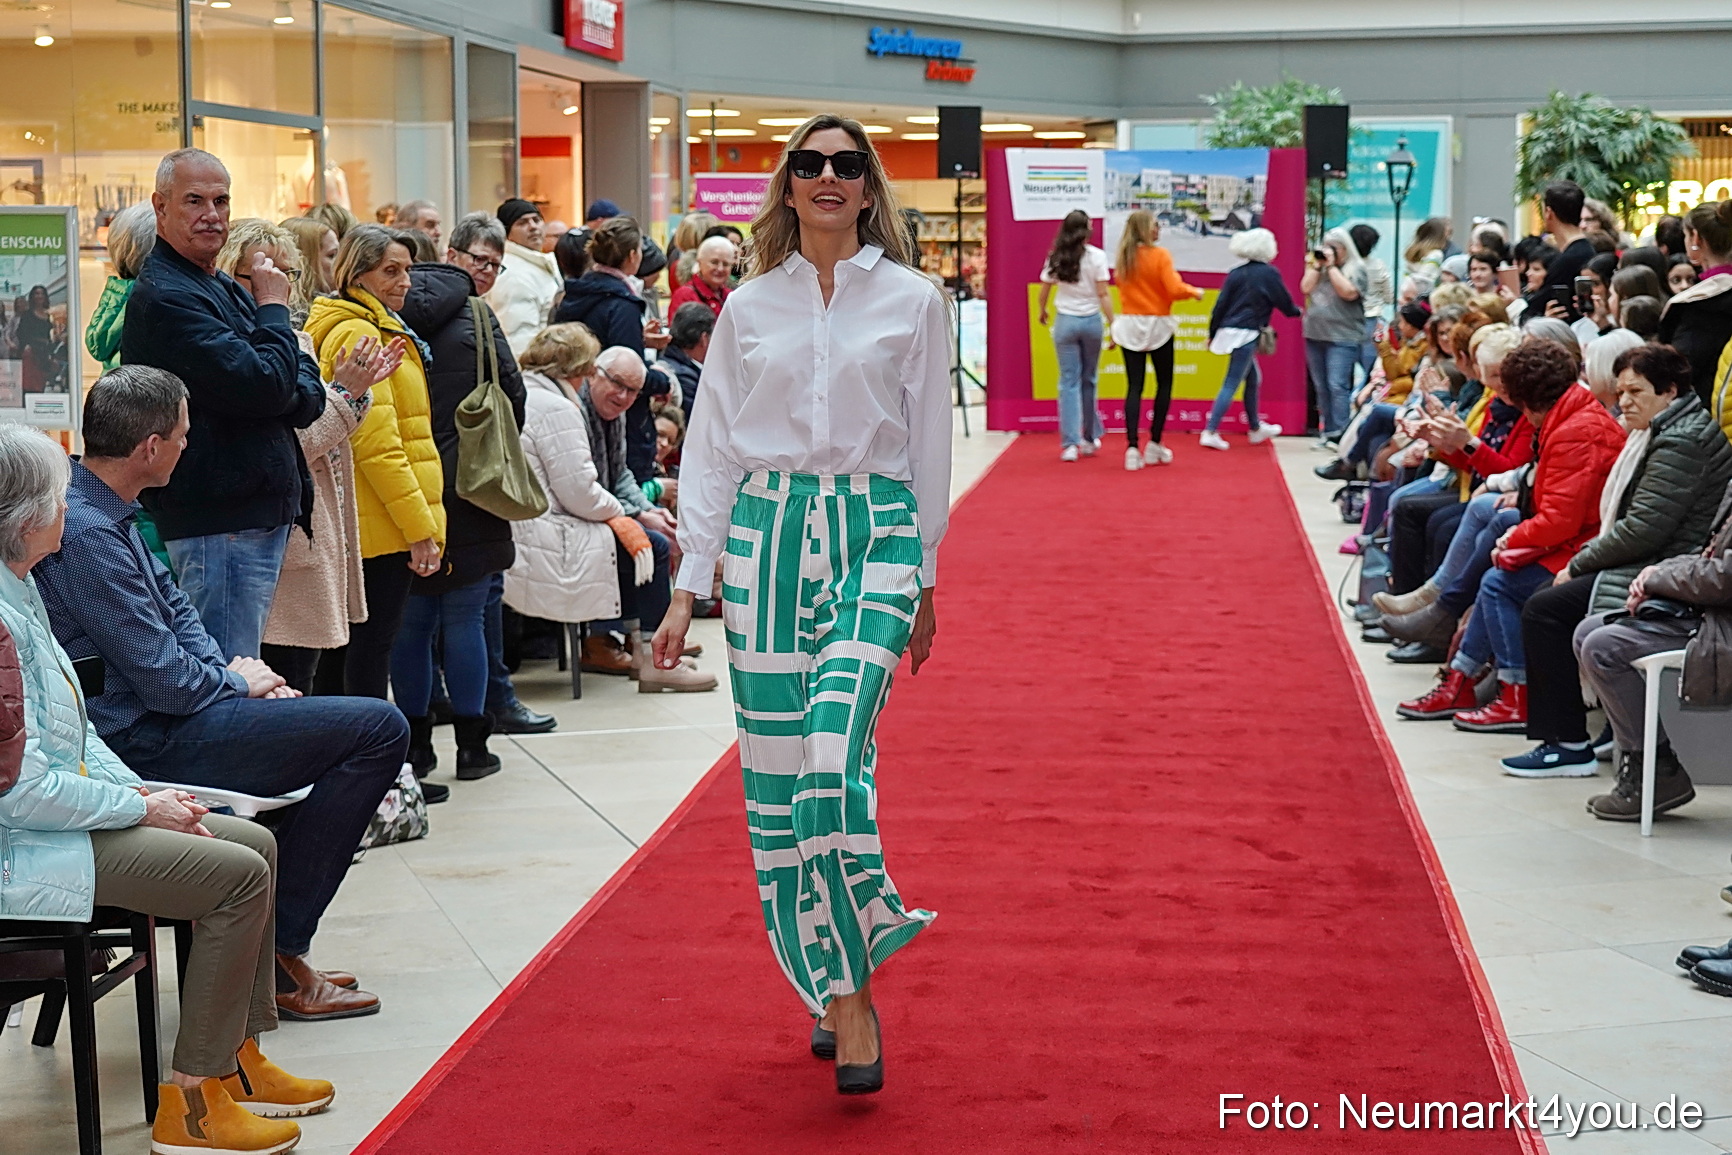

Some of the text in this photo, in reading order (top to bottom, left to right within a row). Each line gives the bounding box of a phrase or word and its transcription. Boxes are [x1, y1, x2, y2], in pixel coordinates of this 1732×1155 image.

[117, 102, 180, 113] THE MAKE
[700, 190, 766, 203] Verschenke
[721, 202, 761, 216] Gutsch
[1, 236, 62, 249] ENSCHAU
